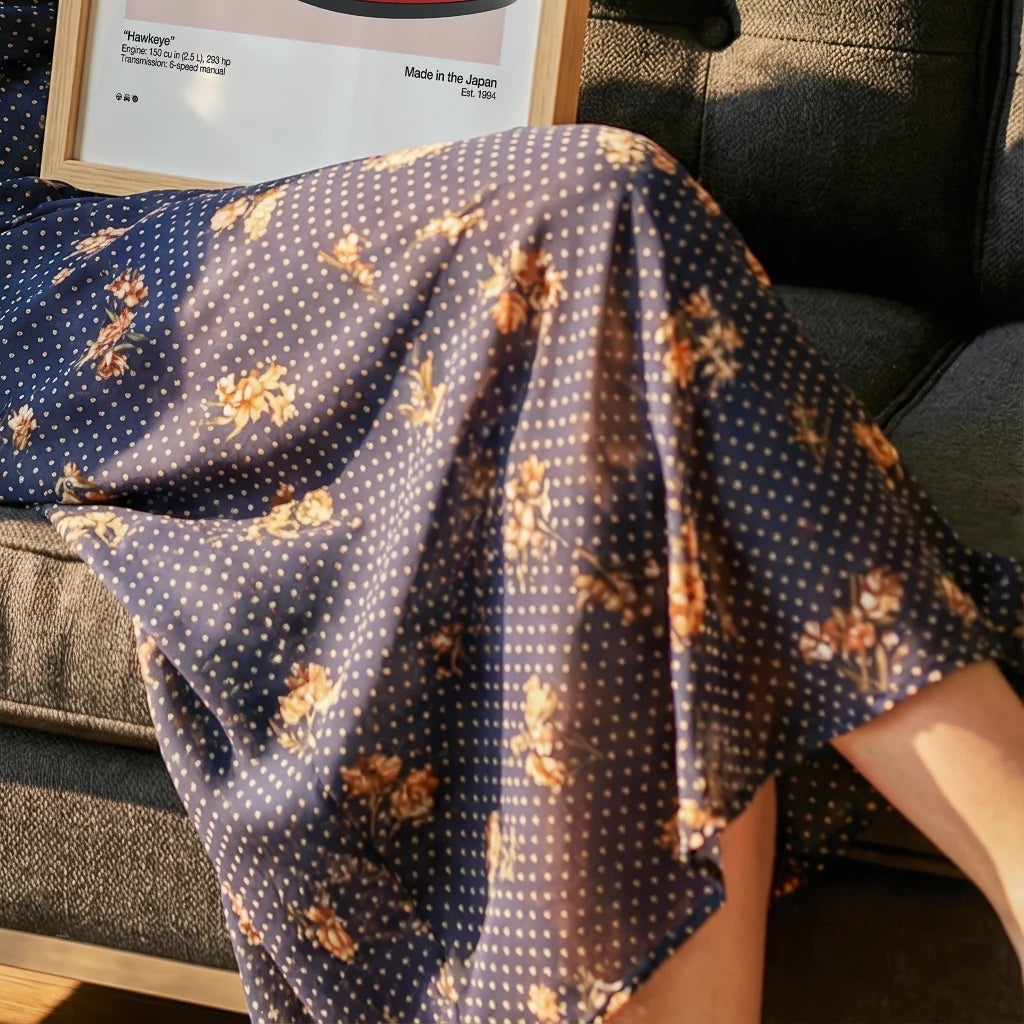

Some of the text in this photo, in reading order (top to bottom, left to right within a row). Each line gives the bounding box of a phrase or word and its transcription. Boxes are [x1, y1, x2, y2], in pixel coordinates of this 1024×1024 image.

[121, 43, 147, 56] Engine:
[149, 47, 162, 57] 150
[163, 50, 172, 58] cu
[173, 50, 181, 59] in
[181, 51, 195, 61] (2.5
[206, 54, 220, 65] 293
[221, 57, 231, 67] hp
[121, 53, 226, 76] Transmission: 6-speed manual
[404, 66, 497, 88] Made in the Japan
[461, 88, 496, 100] Est. 1994
